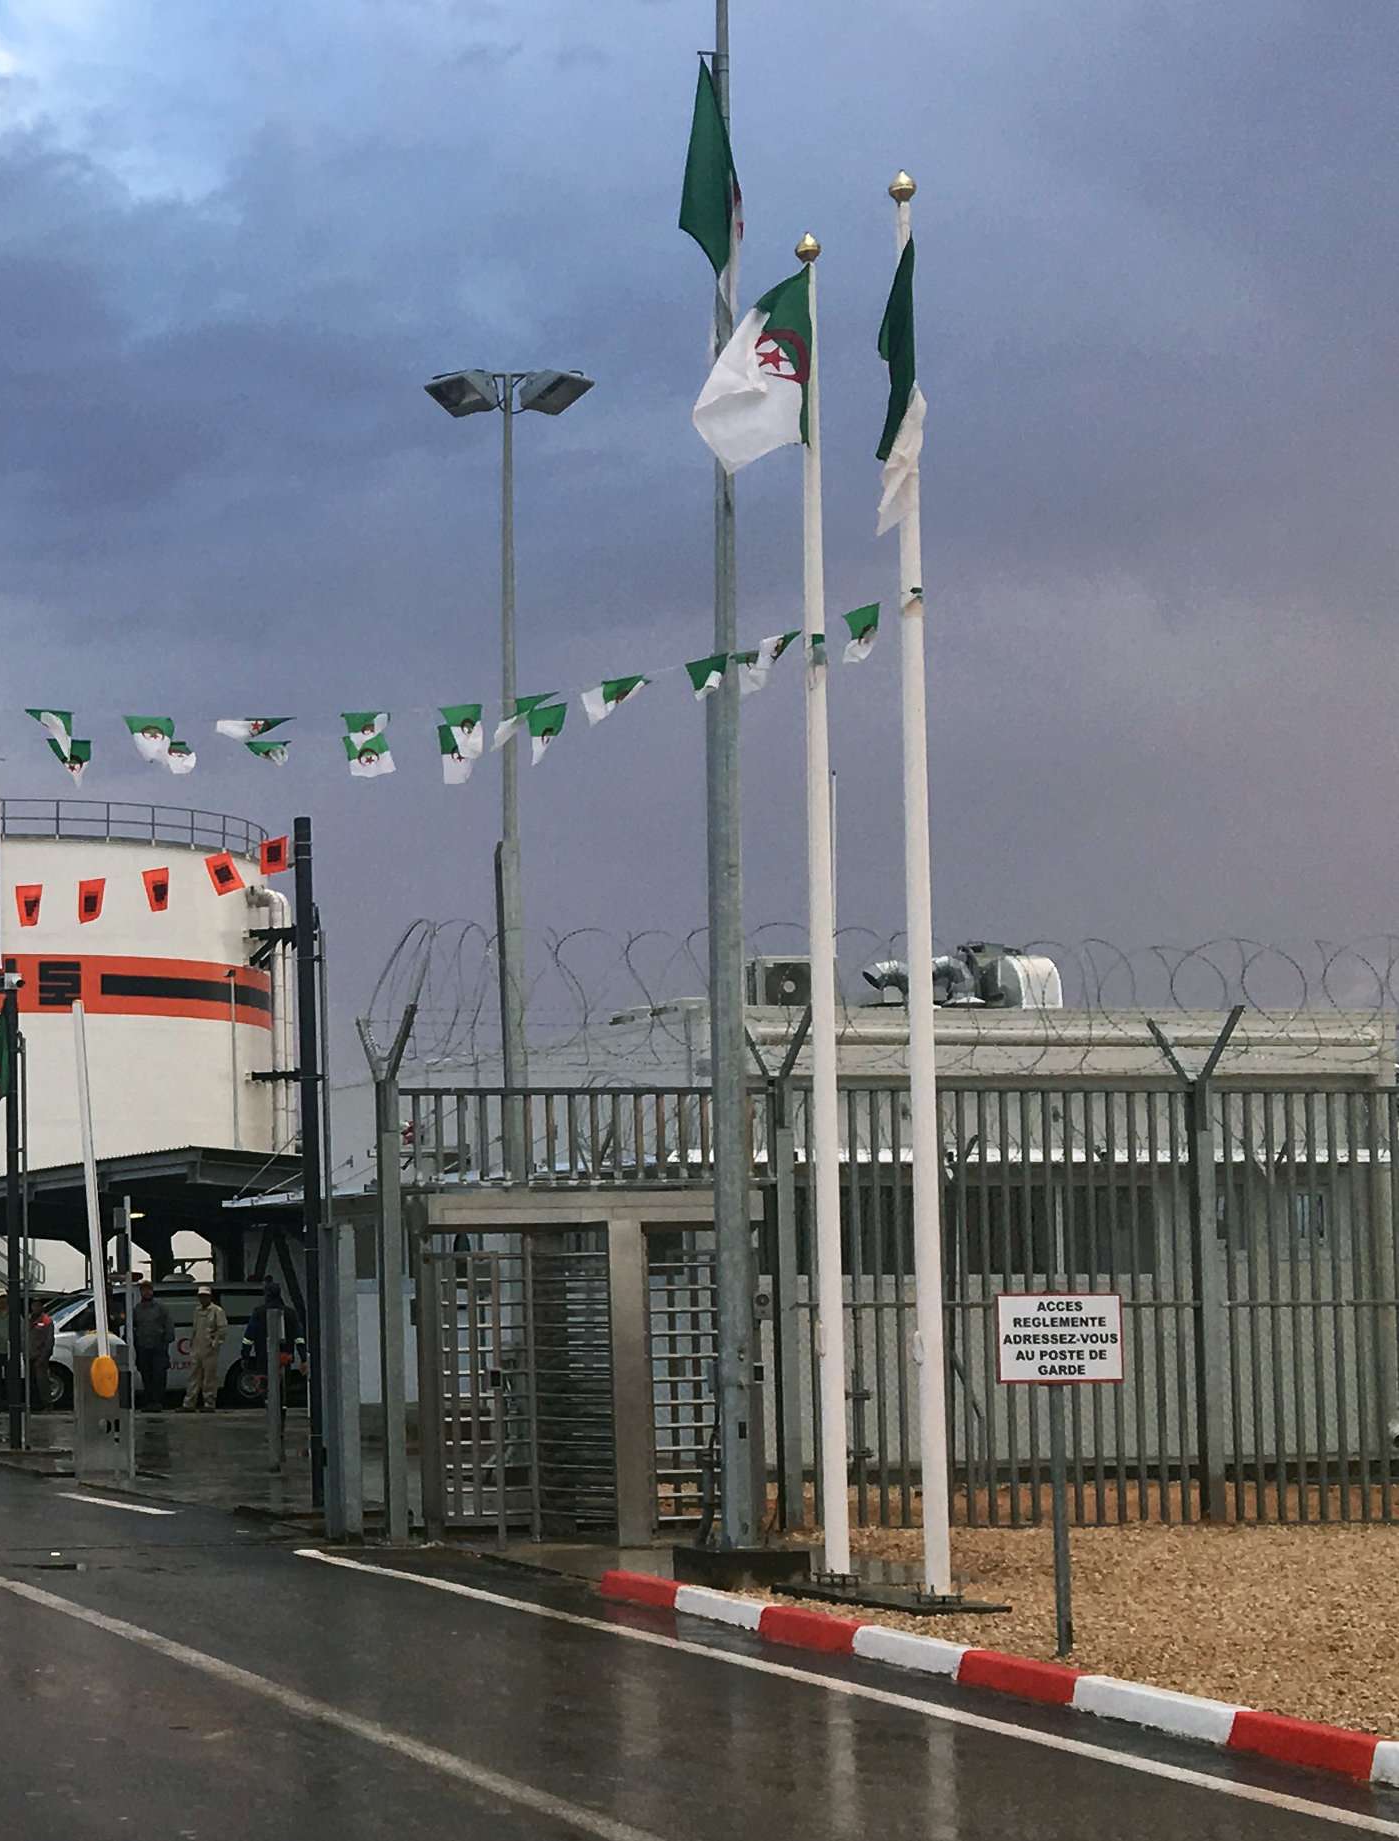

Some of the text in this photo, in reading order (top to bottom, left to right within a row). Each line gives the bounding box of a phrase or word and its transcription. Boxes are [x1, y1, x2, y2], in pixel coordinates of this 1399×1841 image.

[1037, 1301, 1083, 1312] ACCES
[1012, 1317, 1107, 1328] REGLEMENTE
[1003, 1333, 1118, 1345] ADRESSEZ-VOUS
[1015, 1349, 1108, 1361] AU POSTE DE
[1037, 1365, 1086, 1376] GARDE
